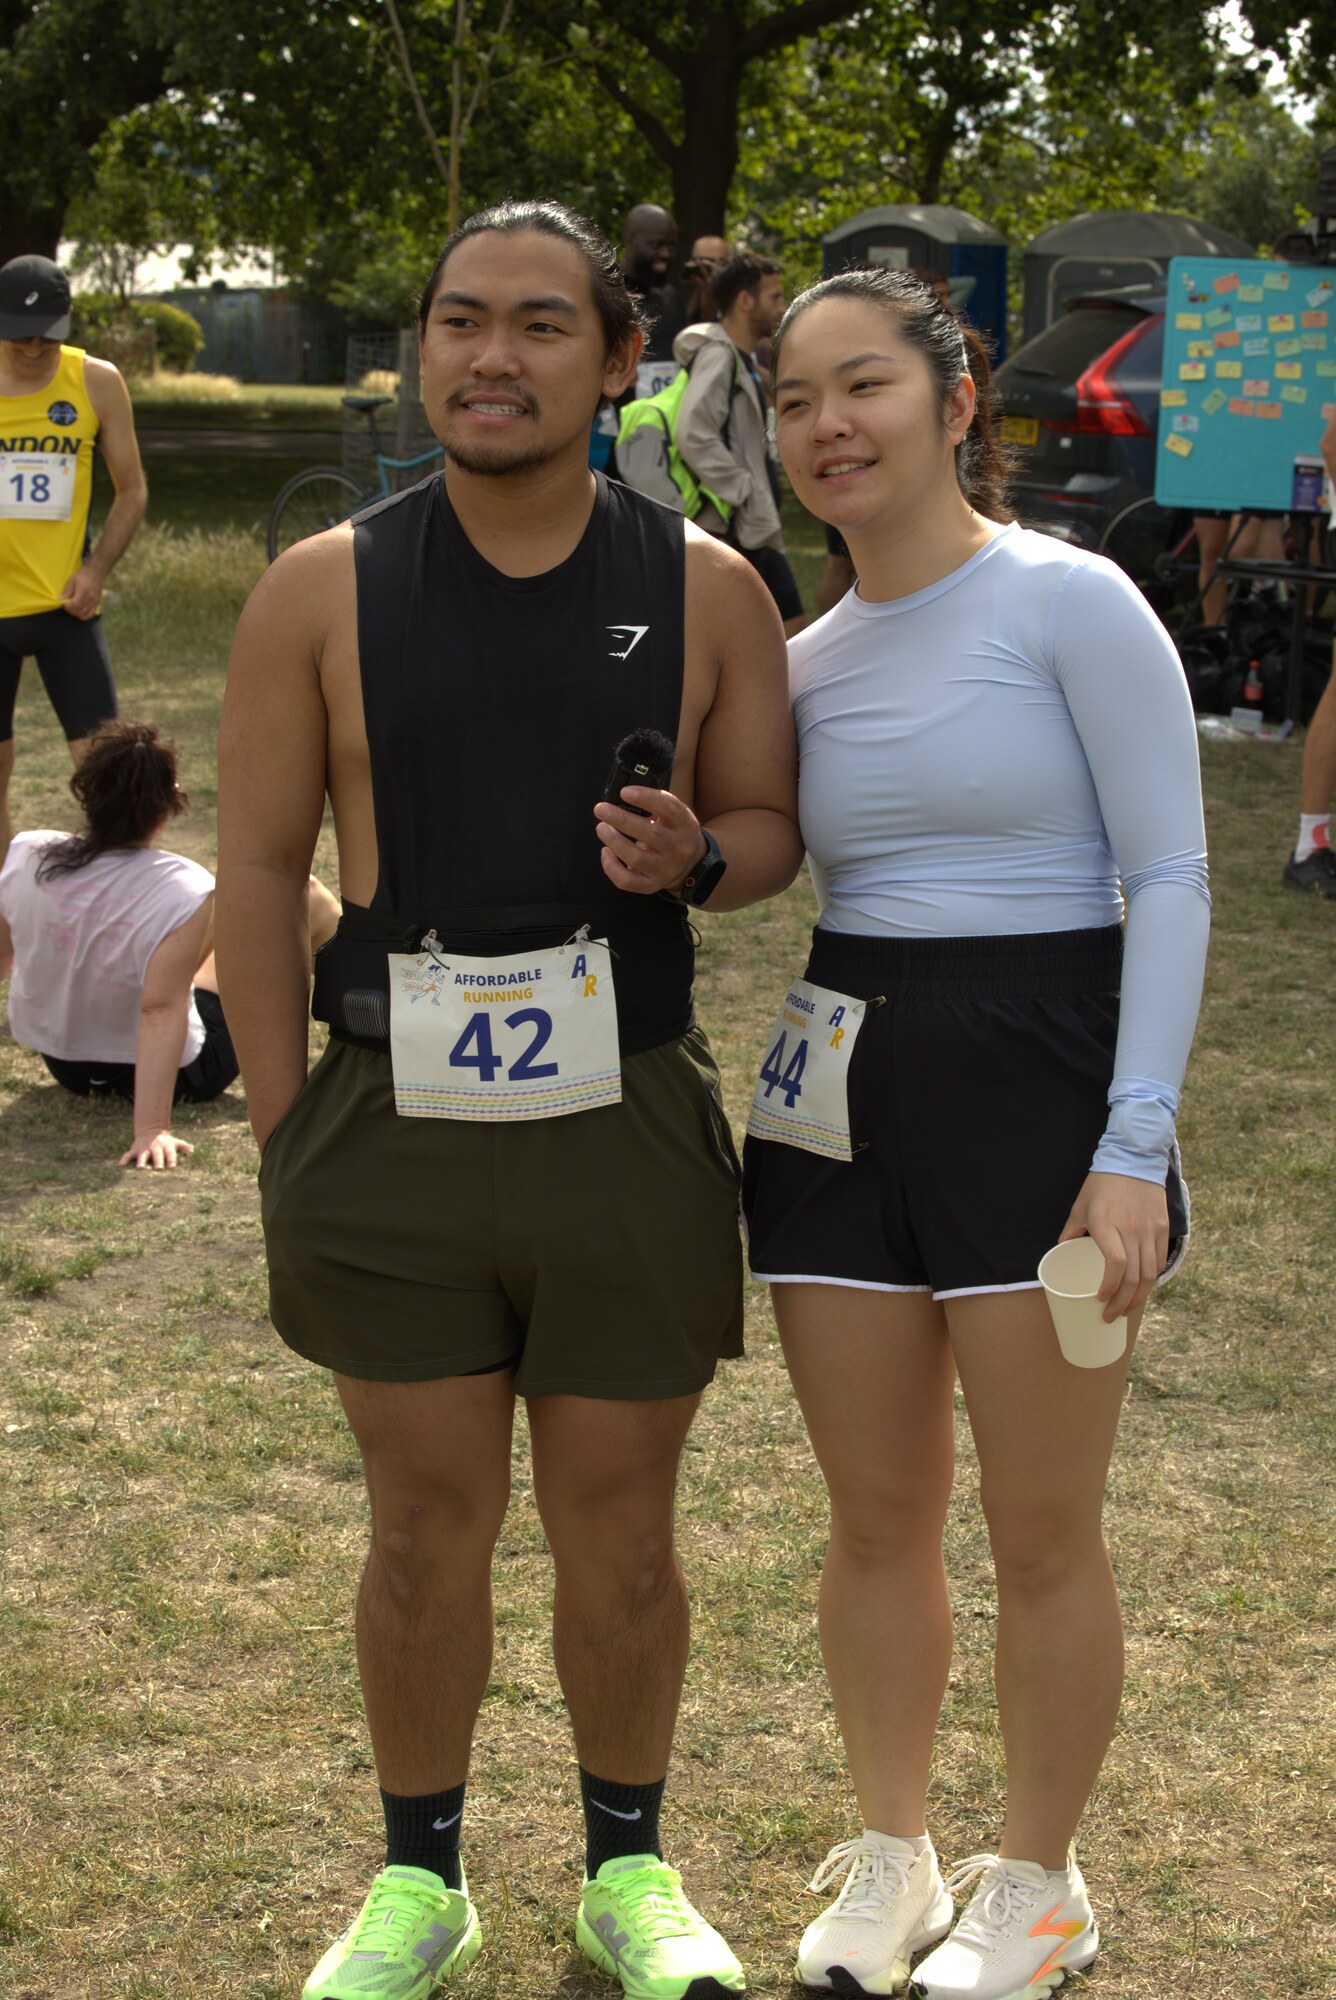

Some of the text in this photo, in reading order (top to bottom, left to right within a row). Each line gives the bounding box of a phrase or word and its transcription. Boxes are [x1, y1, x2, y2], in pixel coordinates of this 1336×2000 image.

[0, 436, 82, 454] NDON
[9, 473, 50, 503] 18
[454, 968, 542, 986] AFFORDABLE
[571, 954, 587, 979] A
[463, 987, 533, 1003] RUNNING
[583, 974, 598, 997] R
[828, 1005, 846, 1028] A
[448, 1007, 559, 1082] 42
[829, 1027, 845, 1050] R
[759, 1029, 809, 1109] 44
